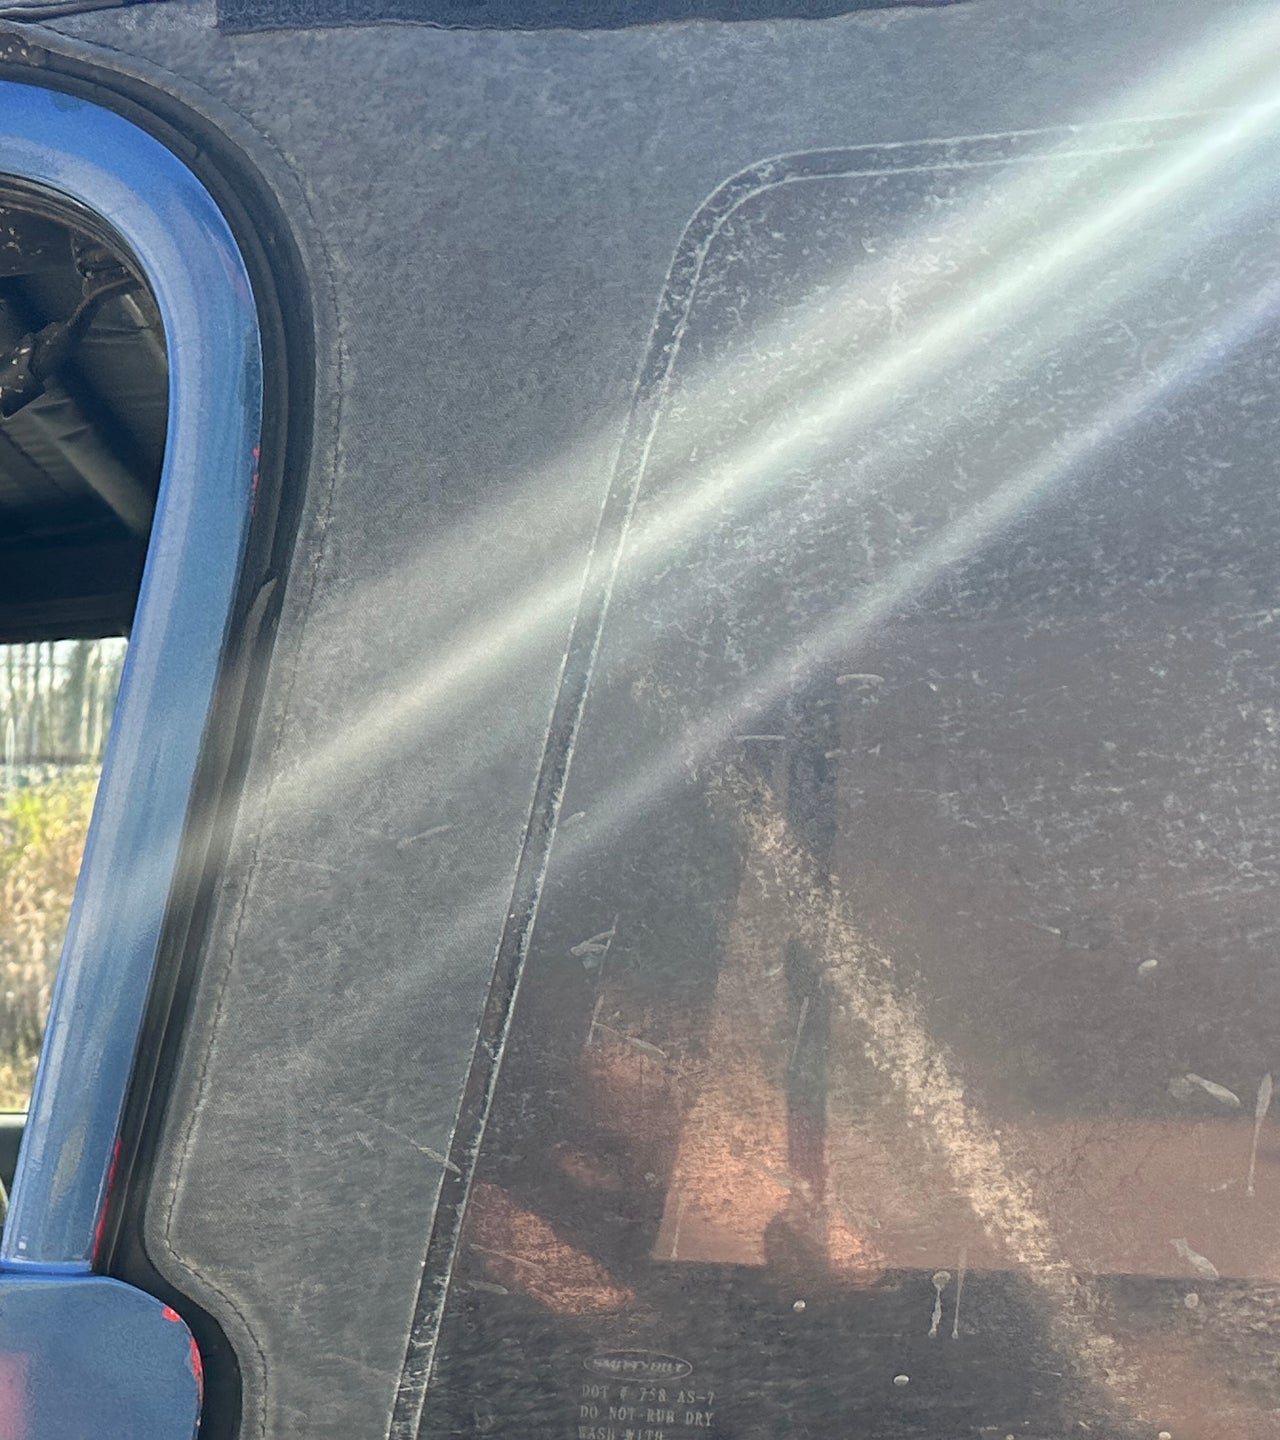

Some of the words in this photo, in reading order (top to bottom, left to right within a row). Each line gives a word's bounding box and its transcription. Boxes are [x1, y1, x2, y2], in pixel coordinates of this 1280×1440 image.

[582, 1384, 608, 1399] DOT
[580, 1405, 599, 1419] DO
[609, 1406, 635, 1421] NOT
[646, 1408, 675, 1424] RUB
[685, 1411, 715, 1427] DRY
